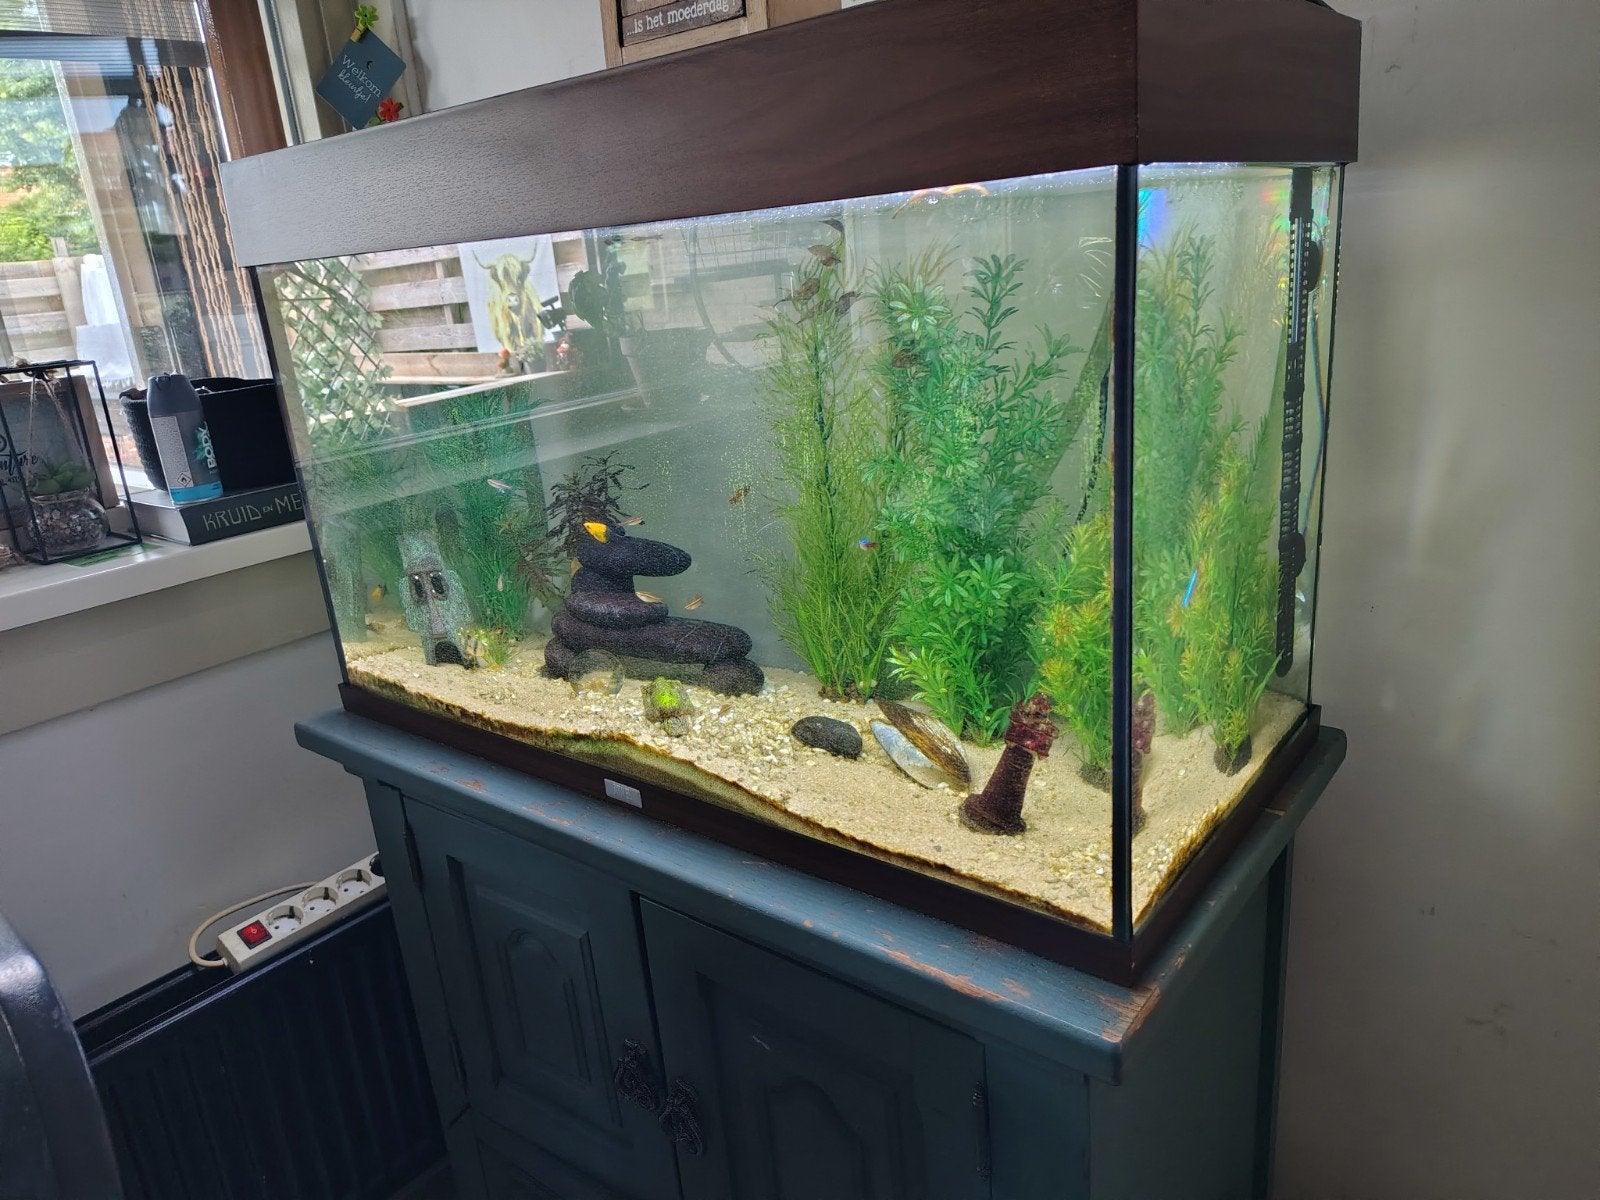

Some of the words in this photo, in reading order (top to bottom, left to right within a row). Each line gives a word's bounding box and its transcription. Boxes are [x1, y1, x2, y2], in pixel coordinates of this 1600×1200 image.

[645, 12, 664, 30] het
[342, 54, 382, 98] Welkom
[203, 505, 262, 532] KRUID
[262, 505, 273, 514] EN
[274, 493, 304, 514] ME
